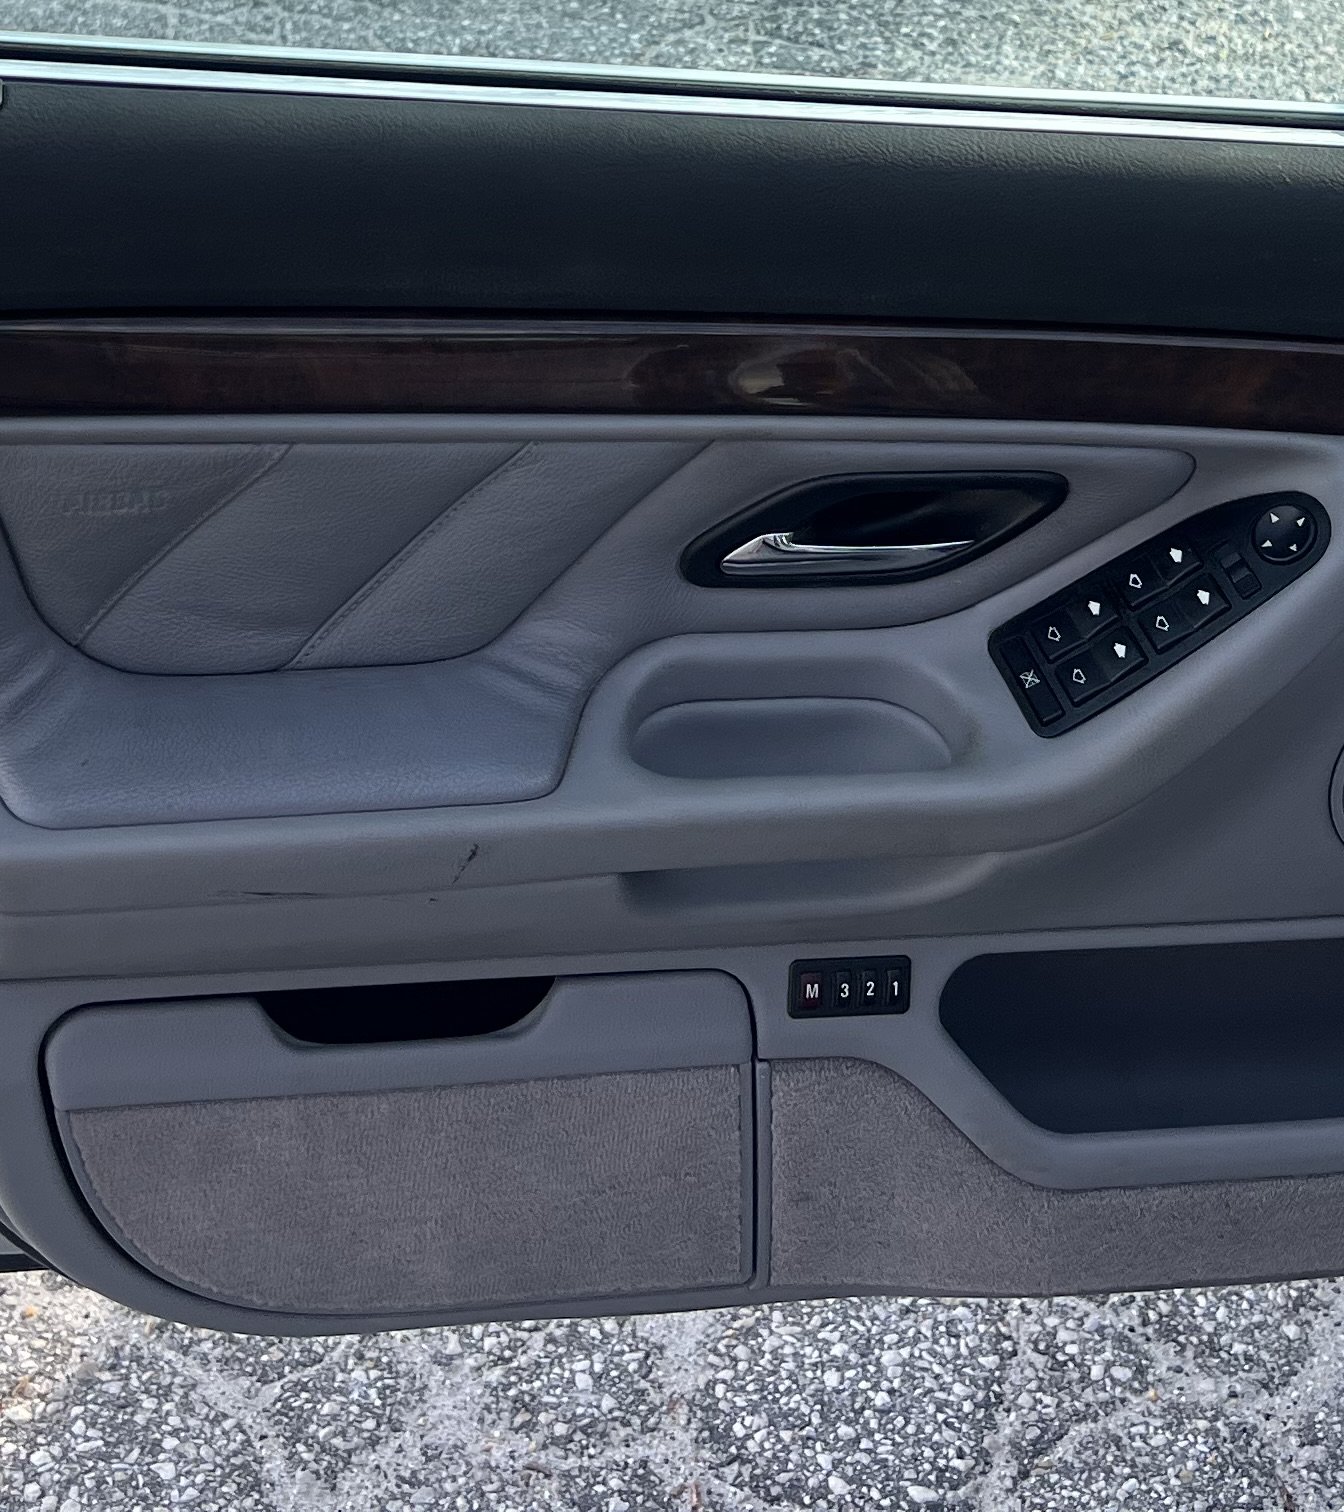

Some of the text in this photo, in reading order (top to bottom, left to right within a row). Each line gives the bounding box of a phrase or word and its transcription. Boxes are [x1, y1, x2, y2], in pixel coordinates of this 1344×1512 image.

[805, 981, 899, 999] M 3 2 1
